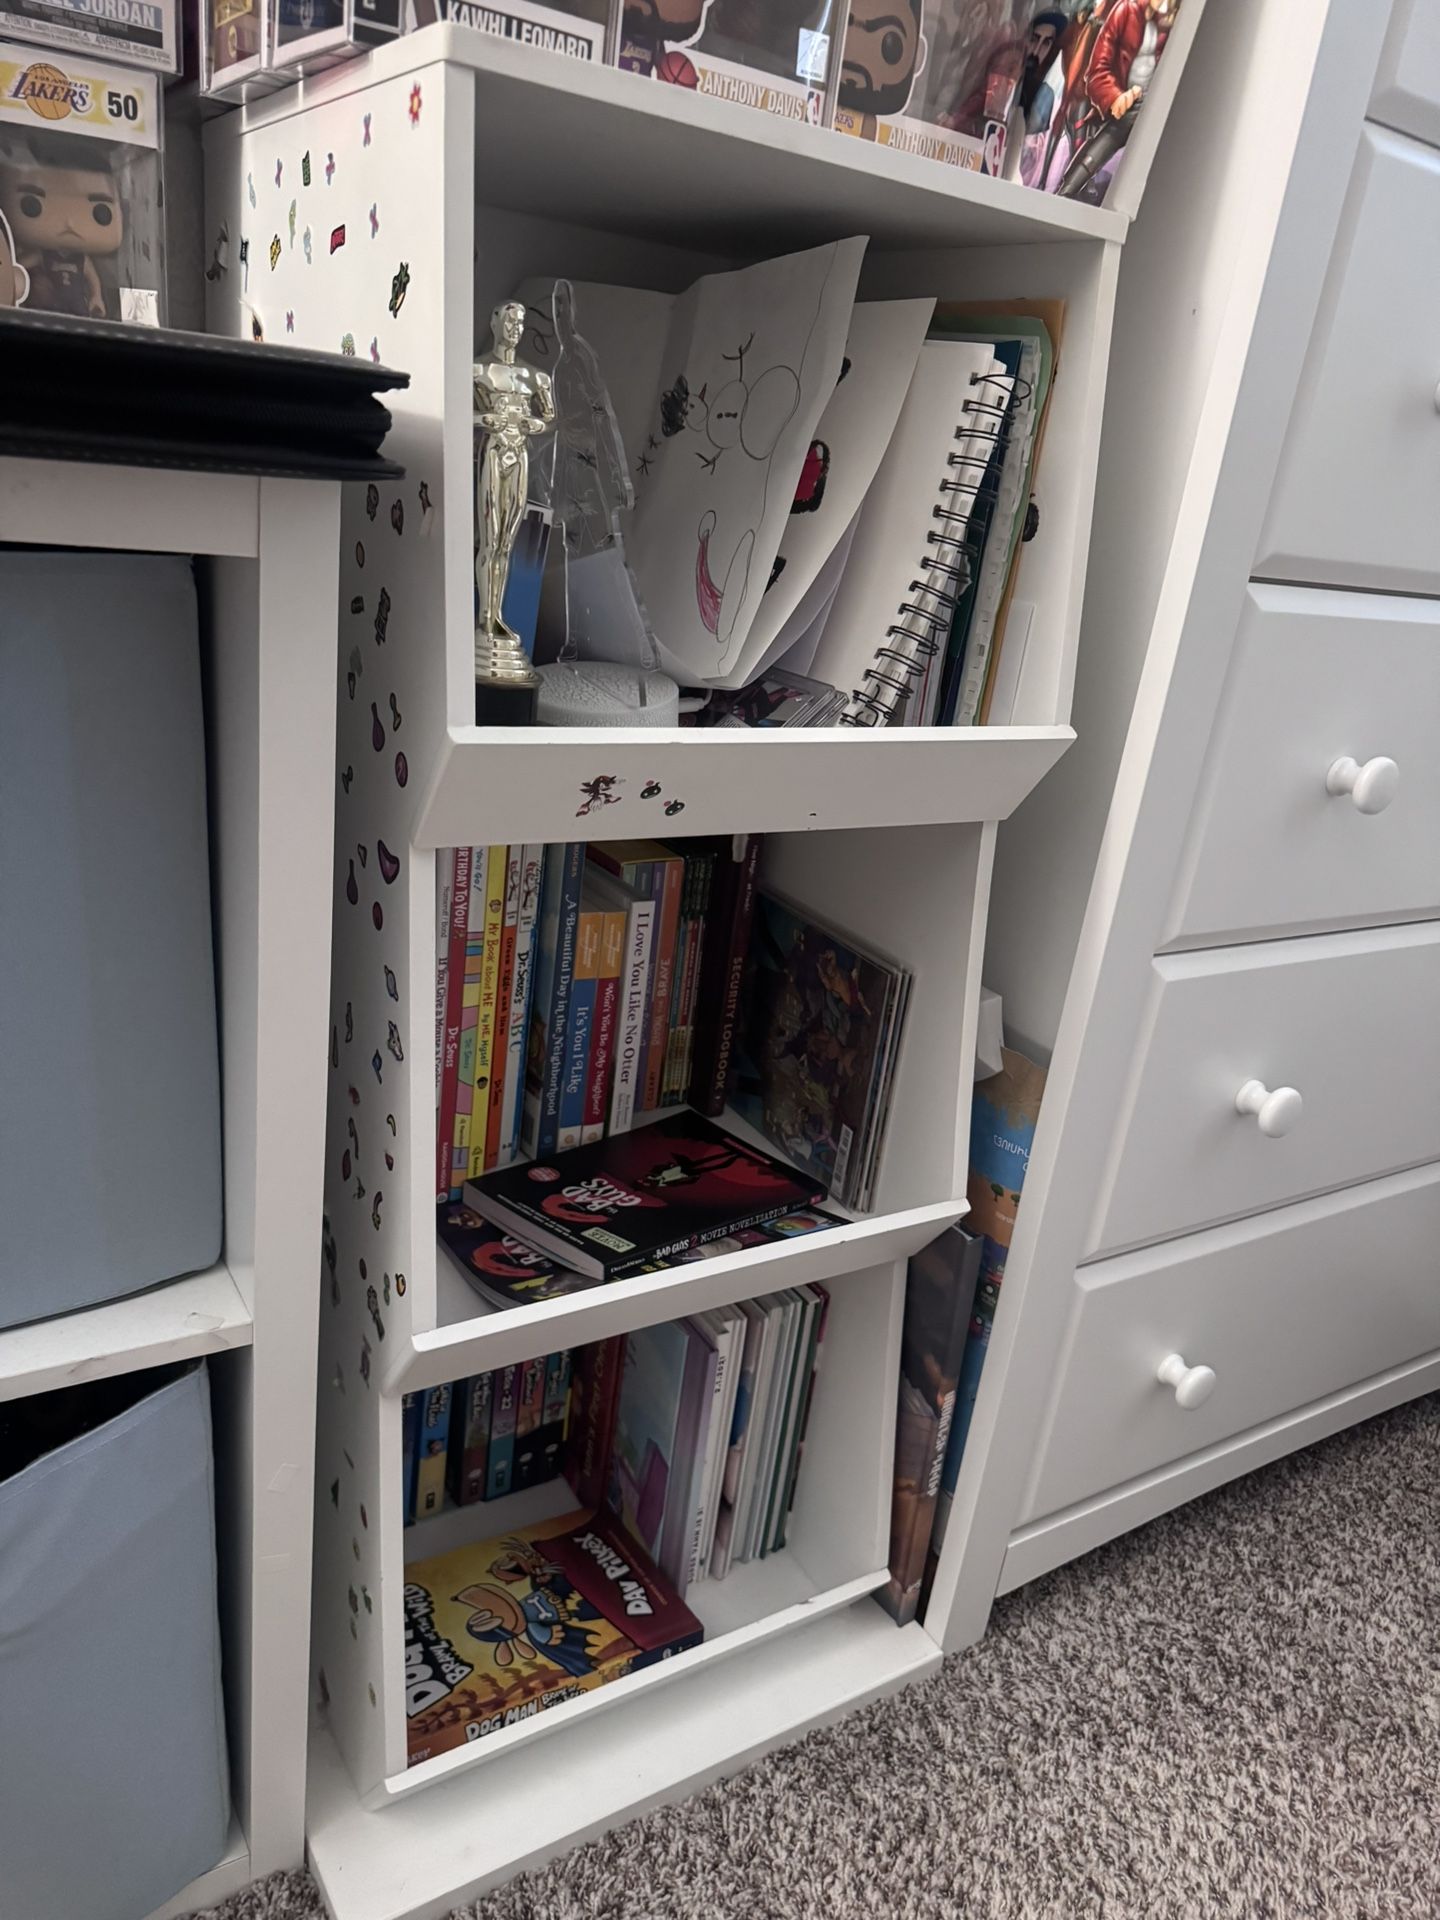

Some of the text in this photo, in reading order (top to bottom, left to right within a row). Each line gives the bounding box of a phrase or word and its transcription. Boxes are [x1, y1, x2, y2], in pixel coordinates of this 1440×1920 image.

[80, 0, 156, 28] JORDAN
[446, 0, 590, 60] KAWHI LEONARD
[8, 71, 94, 113] LAKERS
[107, 91, 138, 121] 50
[702, 71, 805, 120] ANTHONY DAVIS
[887, 128, 975, 170] ANTHONY DAVIS
[453, 902, 465, 928] YOU!
[565, 894, 577, 910] A
[487, 939, 498, 962] Book
[561, 911, 576, 972] Beautiful
[634, 923, 649, 956] Love
[437, 966, 448, 985] You
[484, 966, 494, 990] about
[557, 974, 570, 998] Day
[631, 960, 645, 987] You
[656, 958, 670, 997] BRAVE
[436, 986, 447, 1009] Give
[483, 992, 493, 1008] ME
[602, 982, 615, 1013] Won't
[628, 991, 641, 1021] Like
[555, 1013, 567, 1033] the
[576, 1005, 590, 1026] It's
[601, 1014, 611, 1032] You
[714, 956, 744, 1091] SECURITY LOGBOOK
[445, 1026, 459, 1068] Dr. Seuss
[573, 1027, 587, 1052] You
[599, 1033, 608, 1046] Be
[625, 1024, 638, 1045] No
[594, 1047, 607, 1069] My
[620, 1047, 636, 1085] Otter
[546, 1033, 564, 1116] Neighborhood
[566, 1060, 584, 1094] Like
[562, 1185, 614, 1212] BAD
[580, 1178, 642, 1207] GUYS
[656, 1245, 672, 1260] BAD
[671, 1239, 690, 1255] GUYS
[700, 1226, 728, 1244] MOVIE
[729, 1206, 788, 1234] NOVELIZATION
[619, 1580, 653, 1616] DAV
[429, 1640, 473, 1685] BRAWL
[464, 1715, 502, 1741] DOG
[503, 1699, 539, 1726] MAN
